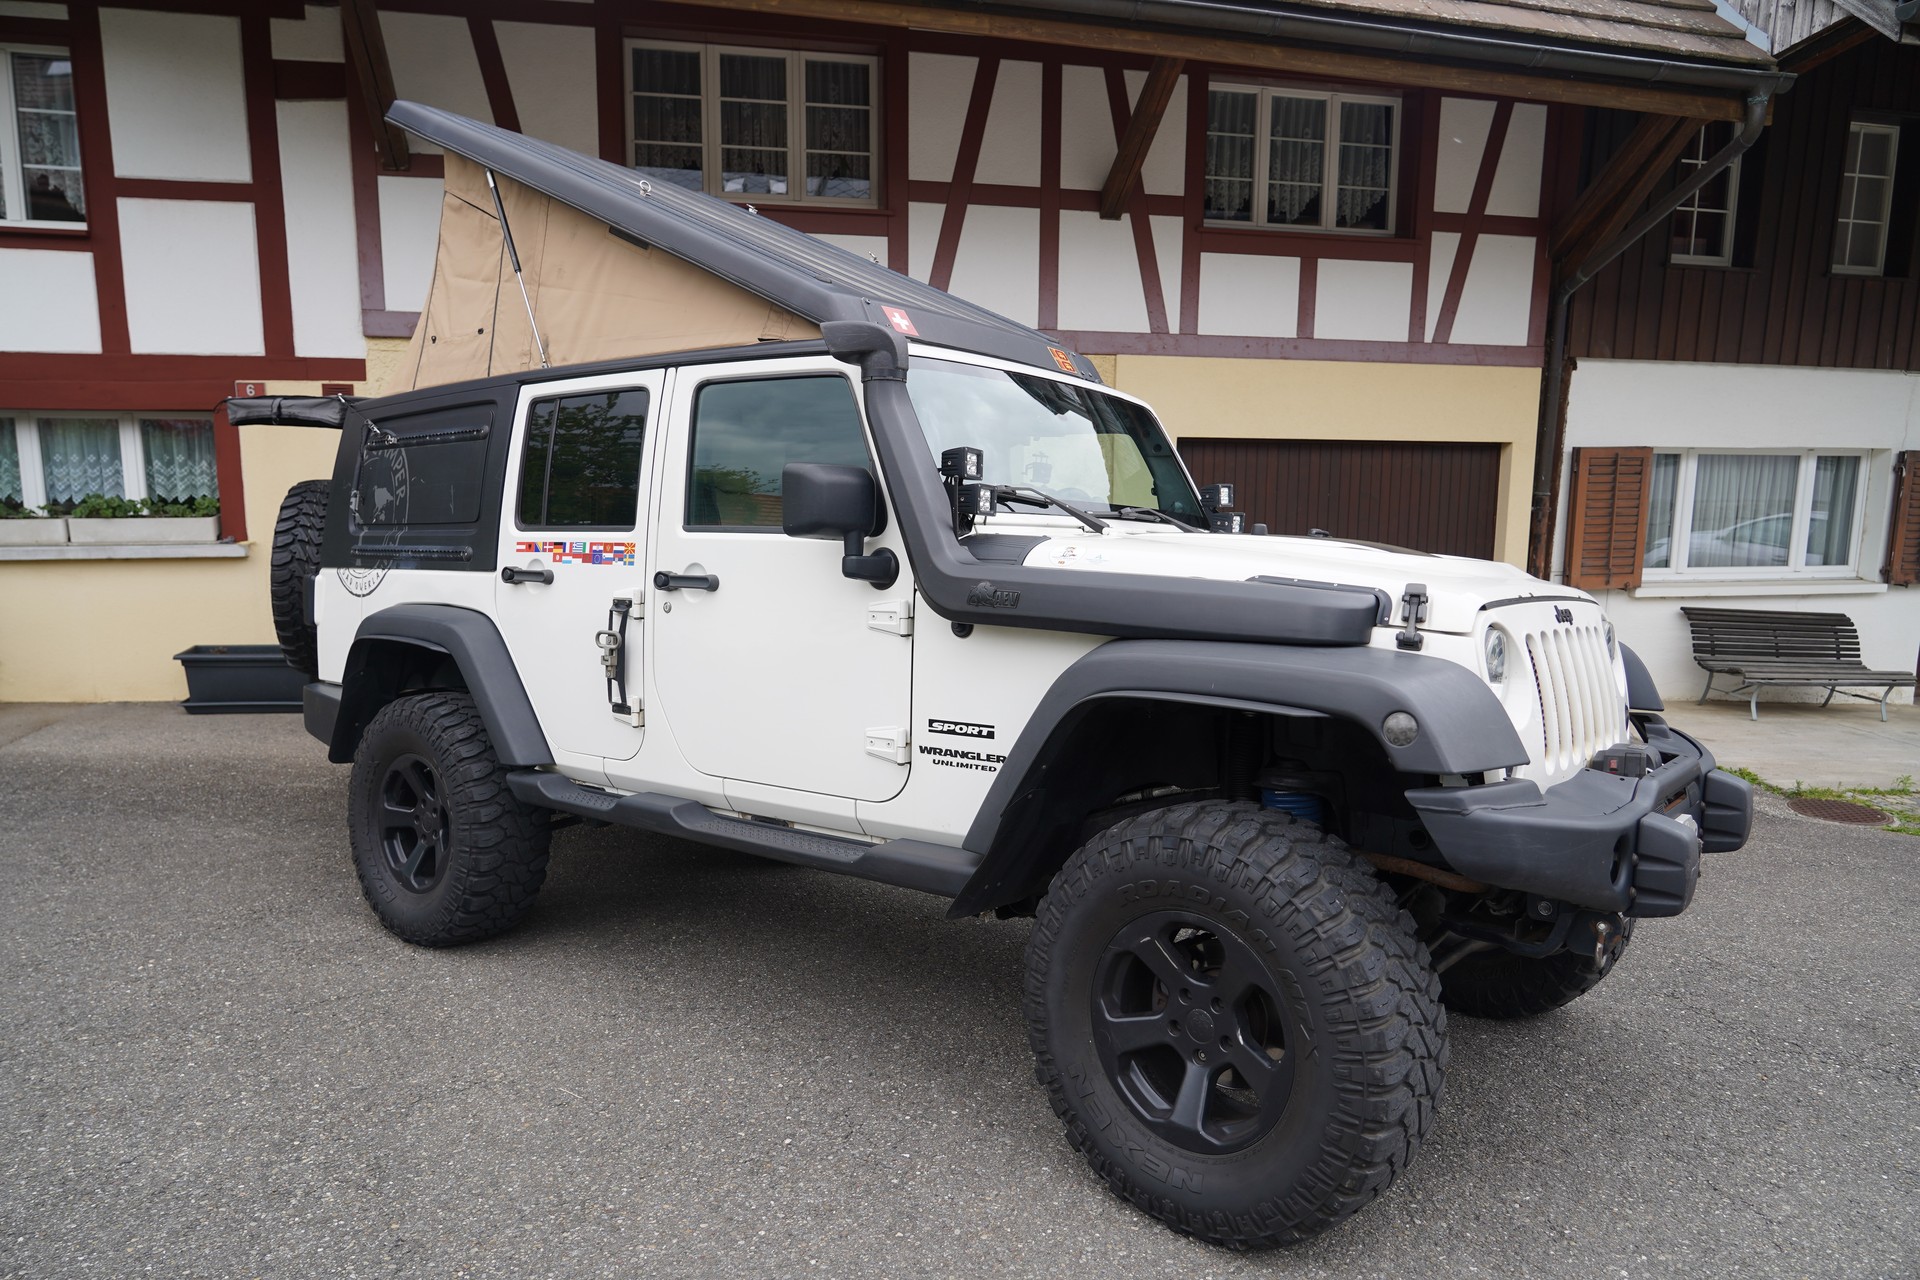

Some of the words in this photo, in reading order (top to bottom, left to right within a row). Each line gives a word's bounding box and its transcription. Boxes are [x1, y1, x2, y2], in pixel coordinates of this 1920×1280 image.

[246, 384, 255, 396] 6
[995, 590, 1020, 607] AEV
[1553, 605, 1573, 625] Jeep
[931, 722, 991, 736] SPORT
[919, 745, 1007, 764] WRANGLER
[932, 759, 997, 772] UNLIMITED
[1067, 1062, 1205, 1195] NEXEN
